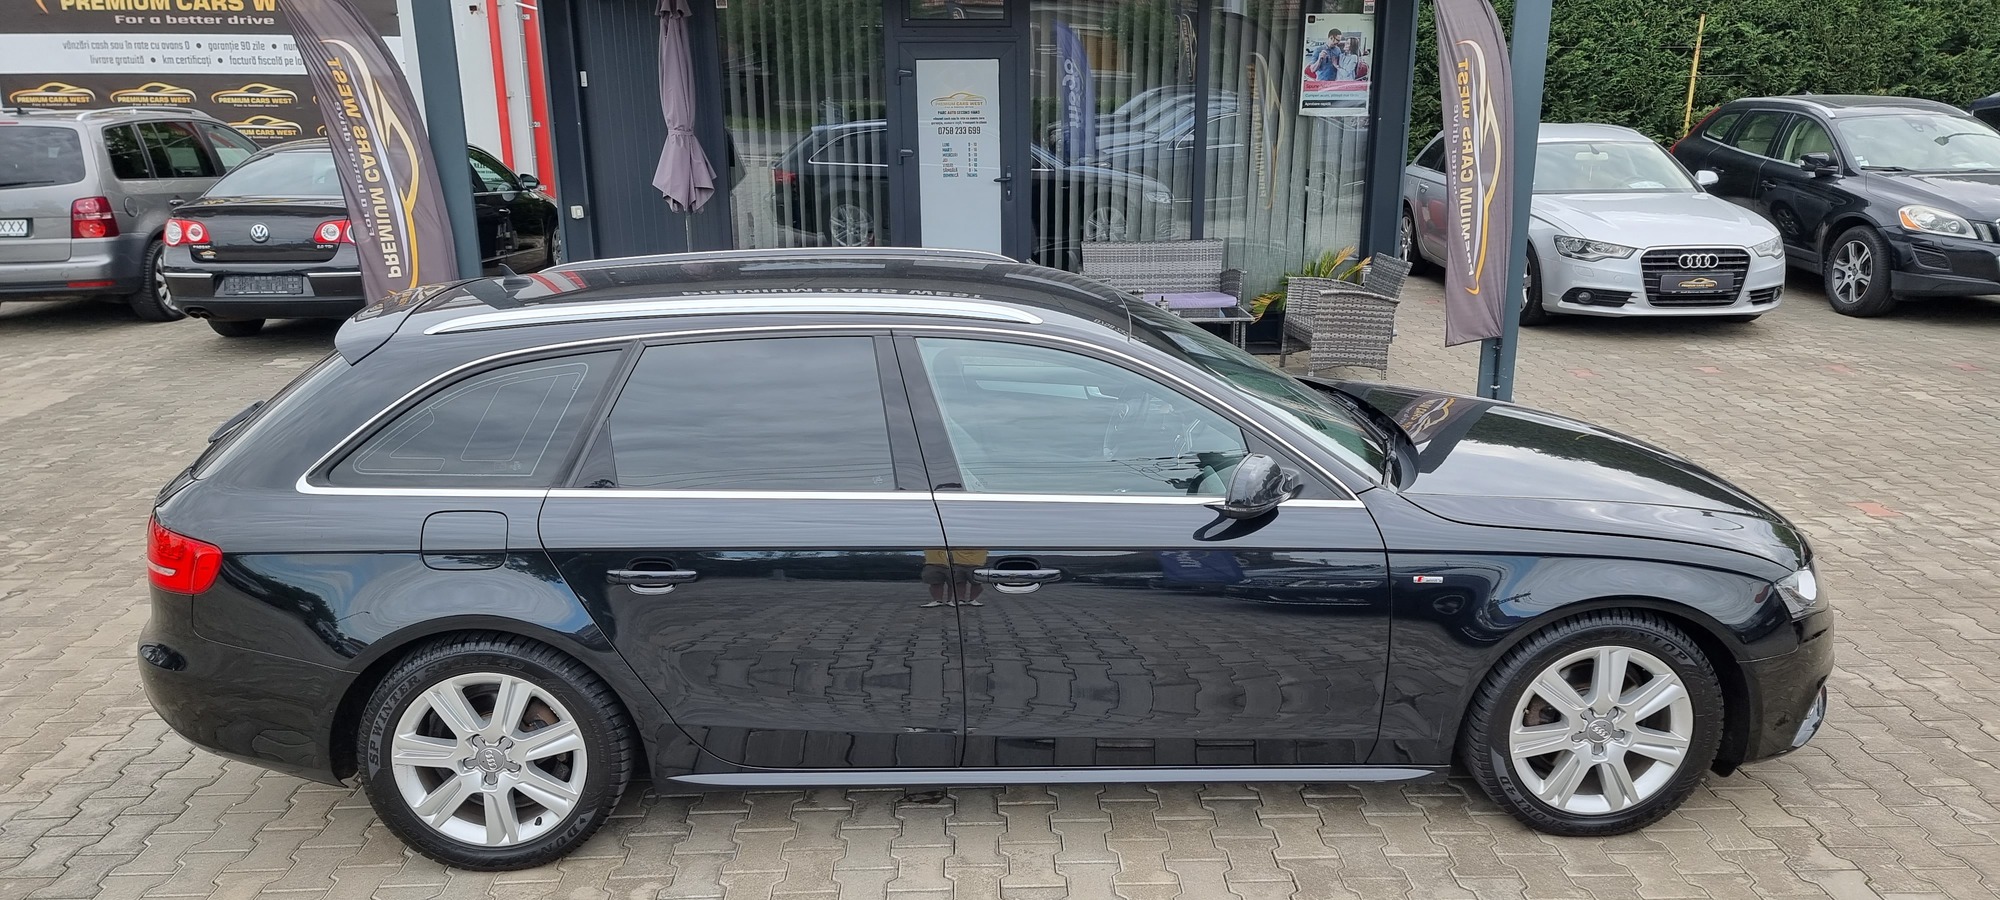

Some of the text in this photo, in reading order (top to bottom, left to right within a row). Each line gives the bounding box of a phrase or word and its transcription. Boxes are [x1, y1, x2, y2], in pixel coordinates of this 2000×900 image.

[60, 0, 171, 11] PREMIUM
[176, 0, 245, 11] CARS
[115, 15, 275, 25] For a better drive
[240, 41, 251, 51] 90
[252, 41, 265, 51] zile
[162, 55, 175, 65] km
[284, 57, 294, 67] pe
[17, 96, 90, 104] PREMIUM CARS WEST
[117, 96, 148, 104] PREMIUM
[149, 96, 169, 104] CARS
[938, 126, 981, 135] 0758 233 699
[372, 675, 421, 736] WINTER
[369, 740, 379, 766] SP
